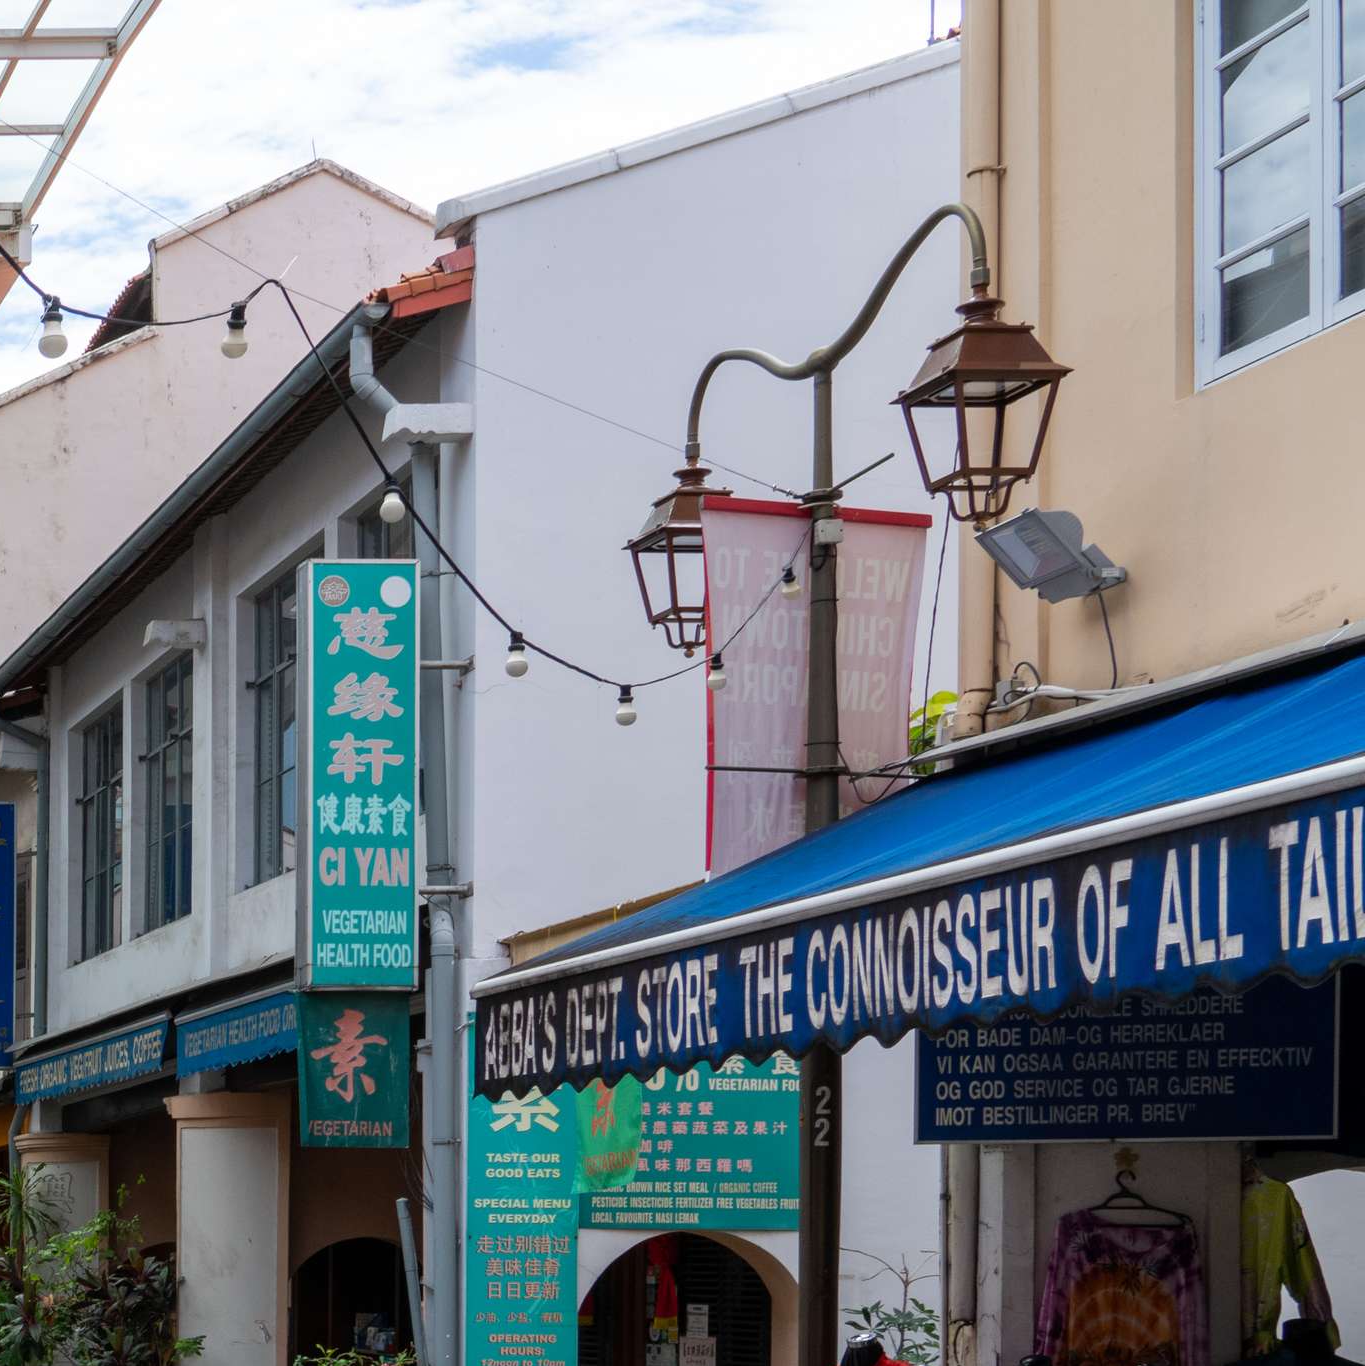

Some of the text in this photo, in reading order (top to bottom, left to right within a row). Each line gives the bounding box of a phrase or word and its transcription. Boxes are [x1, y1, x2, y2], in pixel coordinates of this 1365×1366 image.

[317, 793, 412, 837] 健康素食
[318, 847, 410, 888] CI YAN
[322, 909, 407, 935] VEGETARIAN
[317, 942, 411, 969] HEALTH FOOD
[483, 996, 557, 1081] ABBA'S
[566, 976, 625, 1070] DEPT.
[635, 954, 719, 1055] STORE
[740, 936, 795, 1042] THE
[805, 876, 1058, 1030] CONNOISSEUR
[1076, 857, 1135, 985] OF
[1155, 835, 1246, 971] ALL
[184, 1022, 227, 1059] VEGETARIAN
[228, 1014, 258, 1046] HEALTH
[258, 1010, 280, 1037] FOOD
[977, 1026, 1022, 1048] BADE
[1110, 1022, 1226, 1044] HERREKLAER
[20, 1071, 39, 1094] FRESH
[40, 1060, 68, 1090] ORGANIC
[133, 1029, 163, 1064] COFFEE
[310, 1009, 388, 1102] 素
[936, 1047, 1314, 1075] VI KAN OGSAA GARANTERE EN EFFECKTIV
[708, 1078, 777, 1092] VEGETARIAN
[936, 1075, 1235, 1101] OG GOD SERVICE OG TAR GJERNE
[813, 1085, 830, 1147] 22
[935, 1107, 975, 1127] IMOT
[982, 1104, 1099, 1126] BESTILLINGER
[1106, 1103, 1134, 1124] PR.
[485, 1152, 561, 1164] TASTE OUR
[485, 1168, 561, 1179] GOOD EATS
[626, 1181, 653, 1193] BROWN
[655, 1181, 671, 1193] RICE
[673, 1181, 687, 1193] SET
[689, 1181, 709, 1193] MEAL
[719, 1182, 750, 1193] ORGANIC
[752, 1182, 778, 1193] COFFEE
[474, 1198, 572, 1209] SPECIAL MENU
[591, 1196, 628, 1208] PESTICIDE
[630, 1197, 673, 1208] INSECTICIDE
[675, 1197, 714, 1209] FERTILIZER
[716, 1197, 734, 1209] FREE
[736, 1198, 778, 1209] VEGETABLES
[487, 1214, 557, 1225] EVERYDAY
[591, 1212, 700, 1224] LOCAL FAVOURITE NASI LEMAK
[477, 1235, 571, 1255] 走过别错过
[485, 1258, 561, 1278] 美味佳肴
[487, 1281, 561, 1301] 日日更新
[489, 1334, 557, 1344] OPERATING
[500, 1347, 545, 1357] HOURS:
